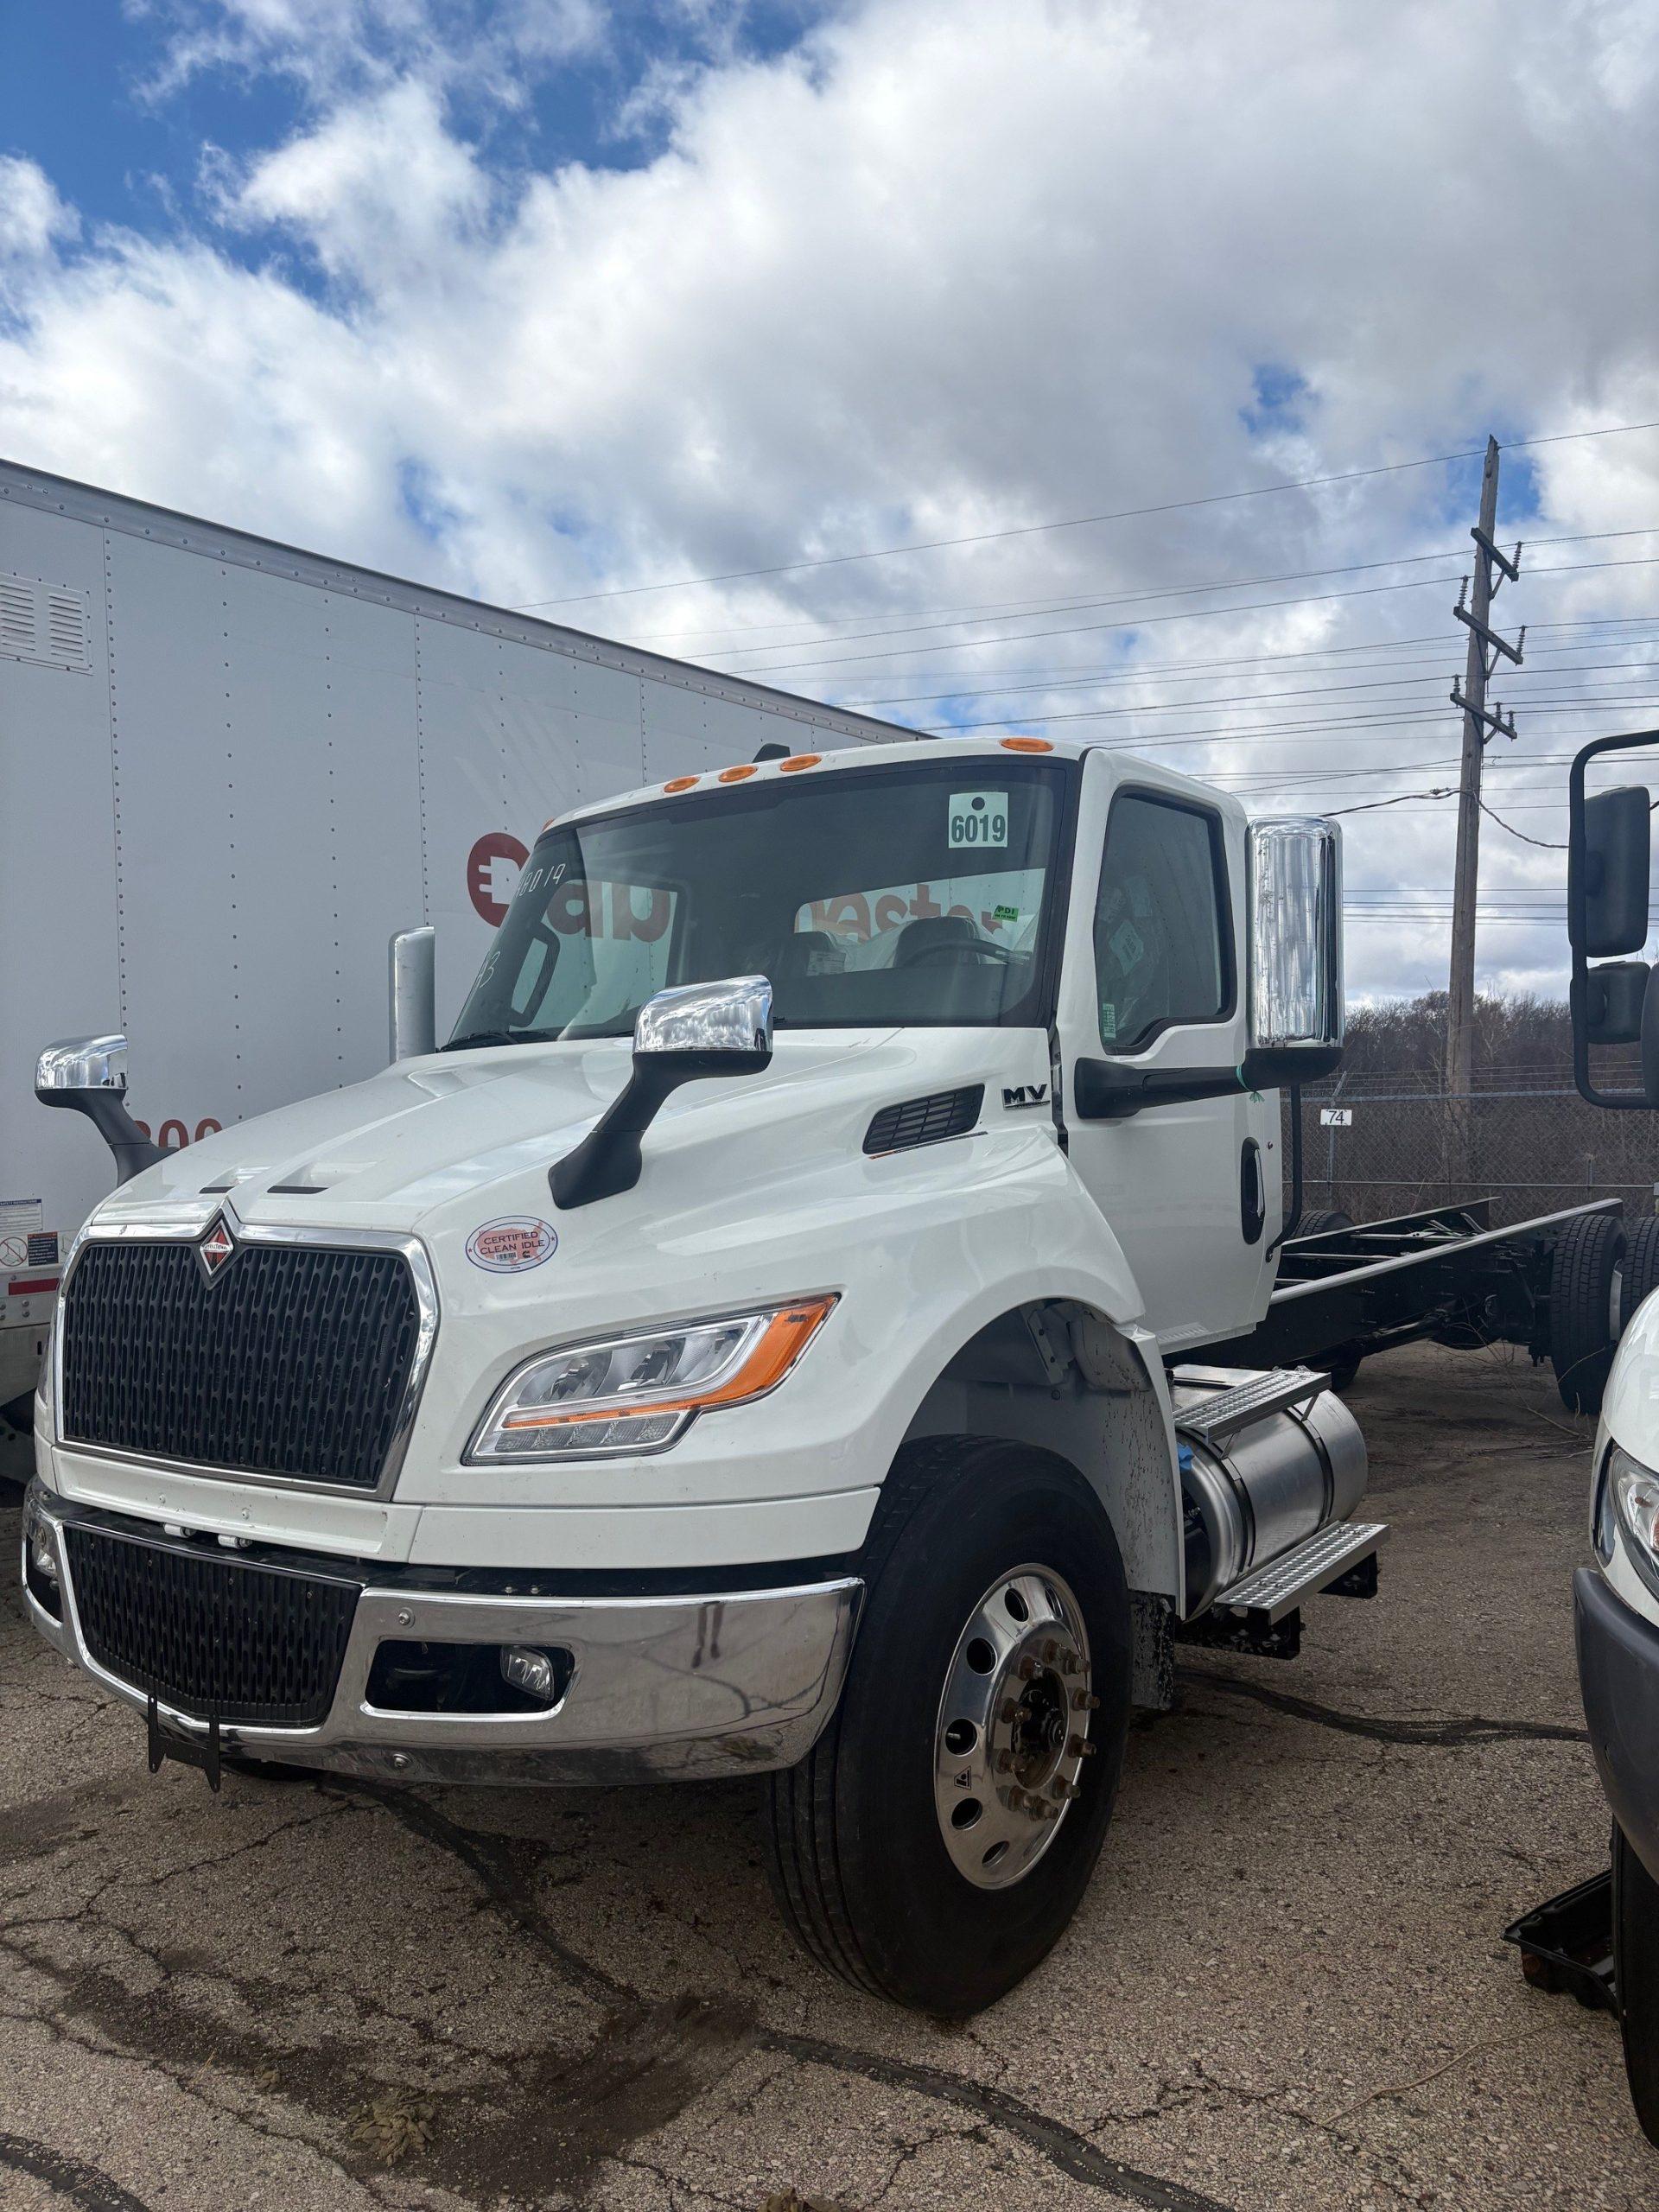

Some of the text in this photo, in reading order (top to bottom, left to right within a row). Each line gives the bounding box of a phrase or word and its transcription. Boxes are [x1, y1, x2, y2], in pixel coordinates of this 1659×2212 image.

[951, 815, 1006, 842] 6019
[1001, 1084, 1048, 1104] MV
[1328, 1110, 1344, 1124] 74
[484, 1231, 538, 1245] CERTIFIED
[480, 1243, 517, 1255] CLEAN
[521, 1239, 545, 1249] IDLE
